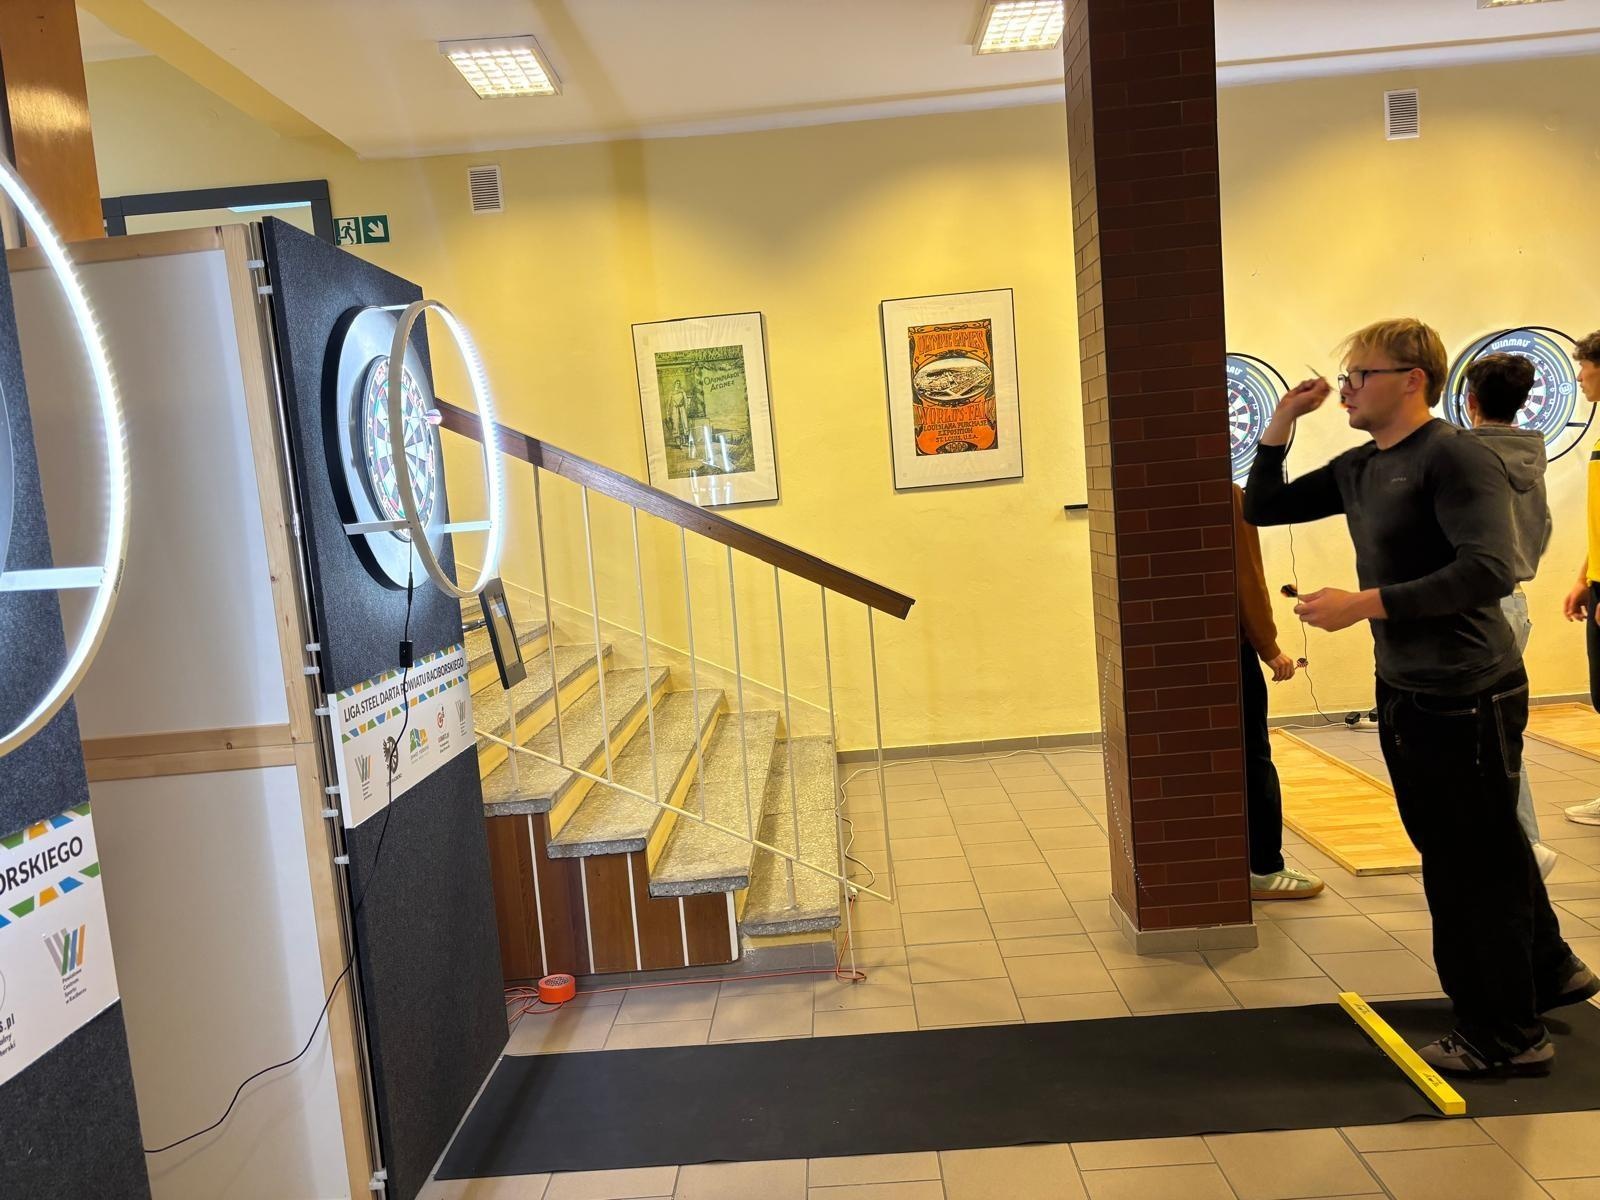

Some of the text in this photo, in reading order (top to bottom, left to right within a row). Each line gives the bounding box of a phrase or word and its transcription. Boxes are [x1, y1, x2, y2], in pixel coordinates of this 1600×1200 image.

[1491, 338, 1531, 351] WINMAU
[344, 657, 464, 723] LIGA STEEL DARTA POWIATU RACIBORSKIEGO
